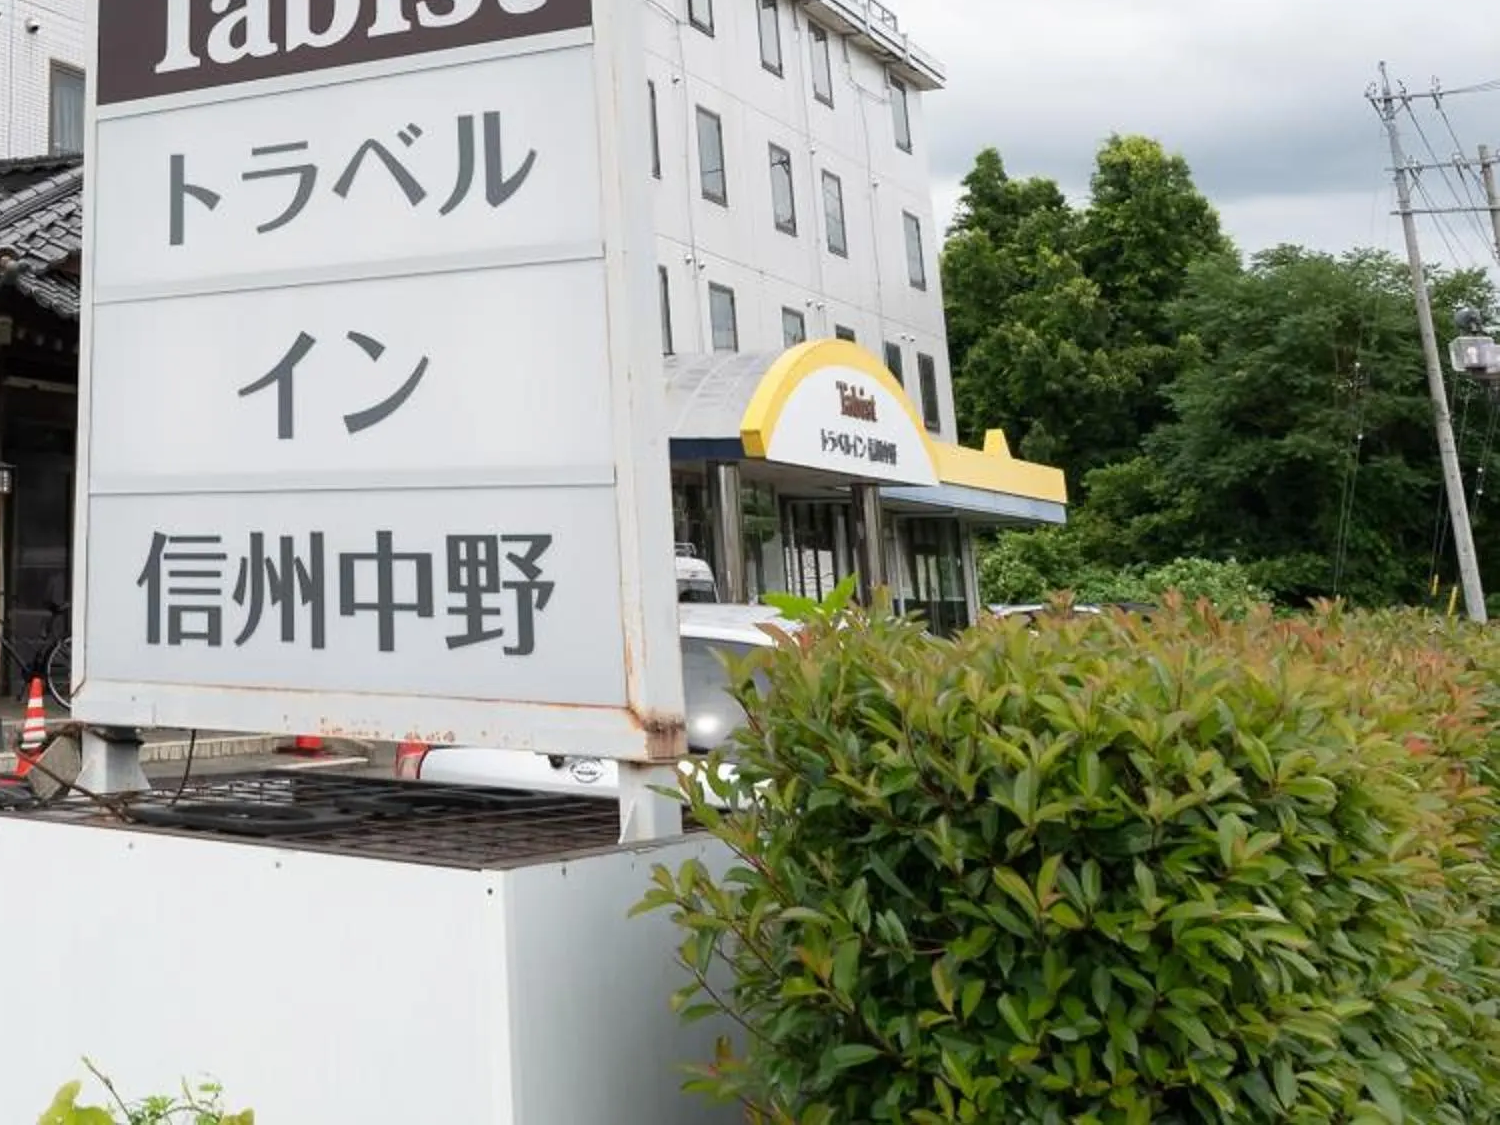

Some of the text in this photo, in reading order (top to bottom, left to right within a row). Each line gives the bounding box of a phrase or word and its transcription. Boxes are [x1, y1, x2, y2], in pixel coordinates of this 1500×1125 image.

[169, 111, 537, 245] トラベル
[237, 331, 428, 439] イン
[137, 531, 555, 656] 信州中野
